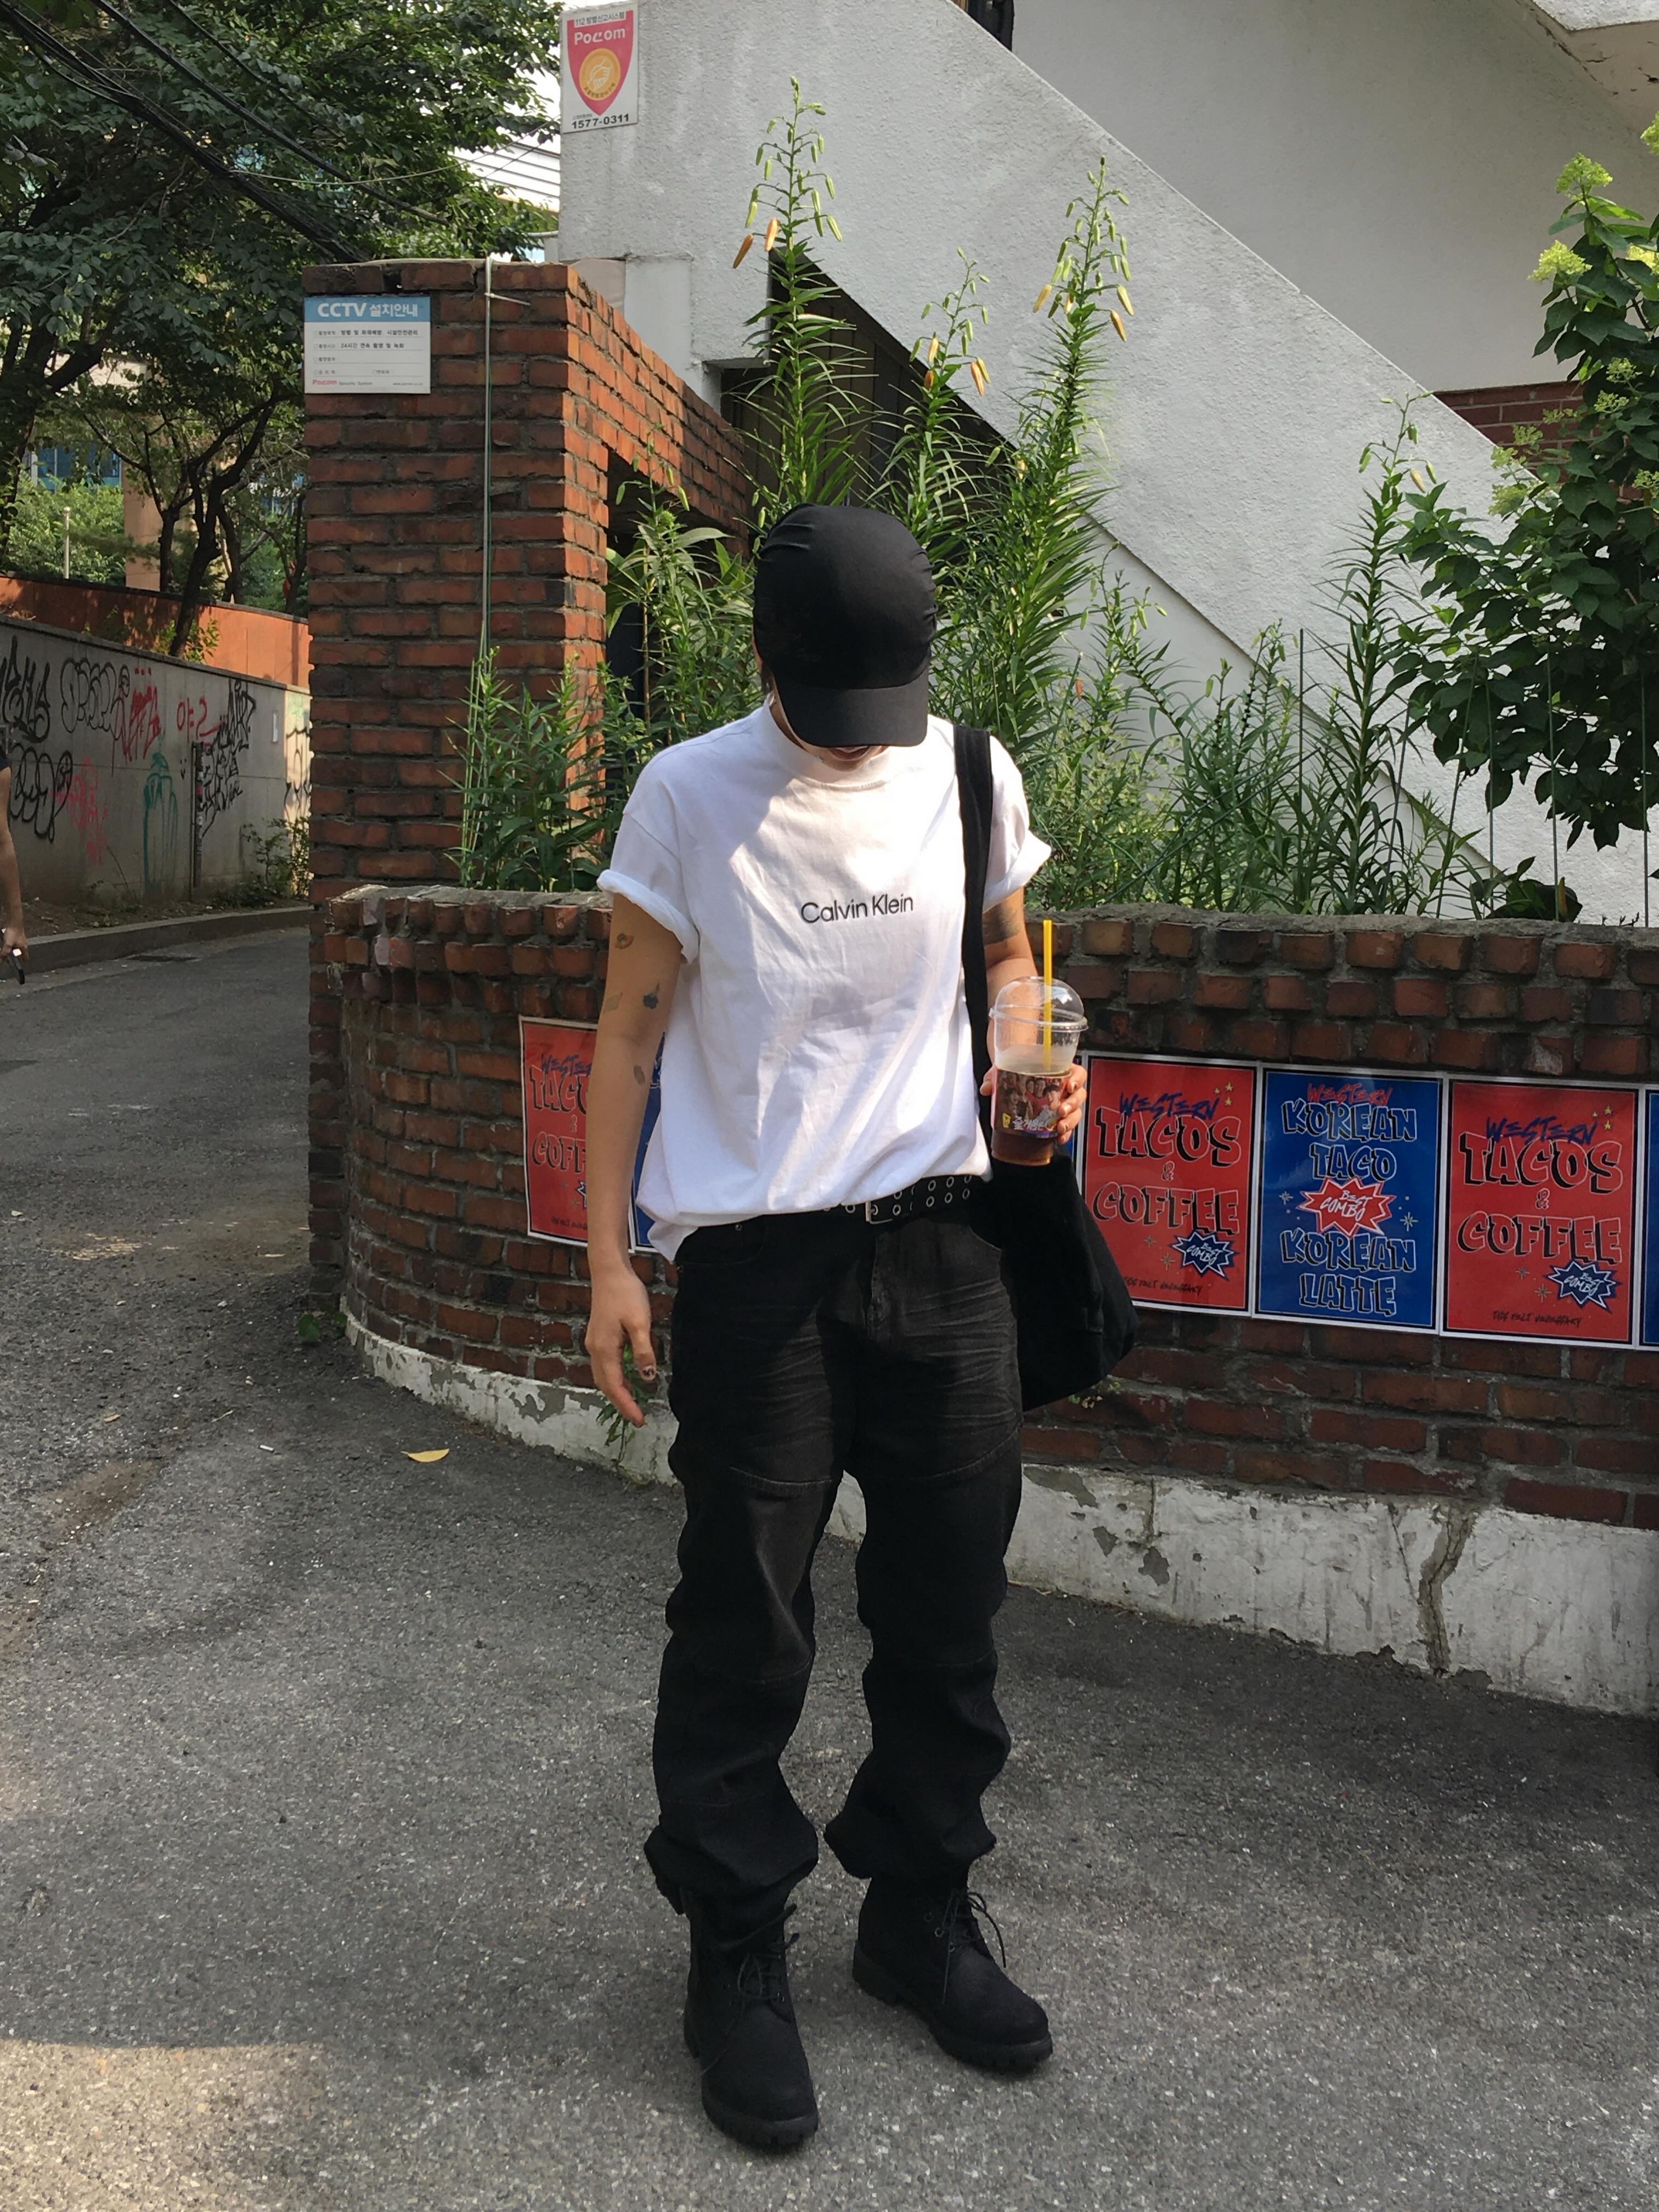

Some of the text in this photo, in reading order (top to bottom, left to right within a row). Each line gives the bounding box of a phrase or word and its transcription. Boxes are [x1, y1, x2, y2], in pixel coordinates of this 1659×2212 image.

[575, 18, 585, 26] 112
[572, 113, 629, 129] 1577-0311
[317, 302, 418, 317] CCTV 설치안내
[800, 894, 913, 923] Calvin Klein
[1119, 1092, 1221, 1121] WESTERN
[1307, 1082, 1393, 1107] WESTERN
[1281, 1099, 1418, 1142] KOREAN
[1486, 1115, 1598, 1146] WESTERN
[1095, 1107, 1242, 1168] TACOS
[1161, 1161, 1175, 1181] &
[1309, 1142, 1397, 1182] TACO
[1459, 1132, 1623, 1195] TACOS
[1092, 1182, 1240, 1236] COFFEE
[1320, 1195, 1366, 1221] COMBO
[1536, 1188, 1550, 1210] &
[1279, 1228, 1417, 1272] KOREAN
[1457, 1210, 1623, 1265] COFFEE
[1299, 1273, 1396, 1317] LATTE
